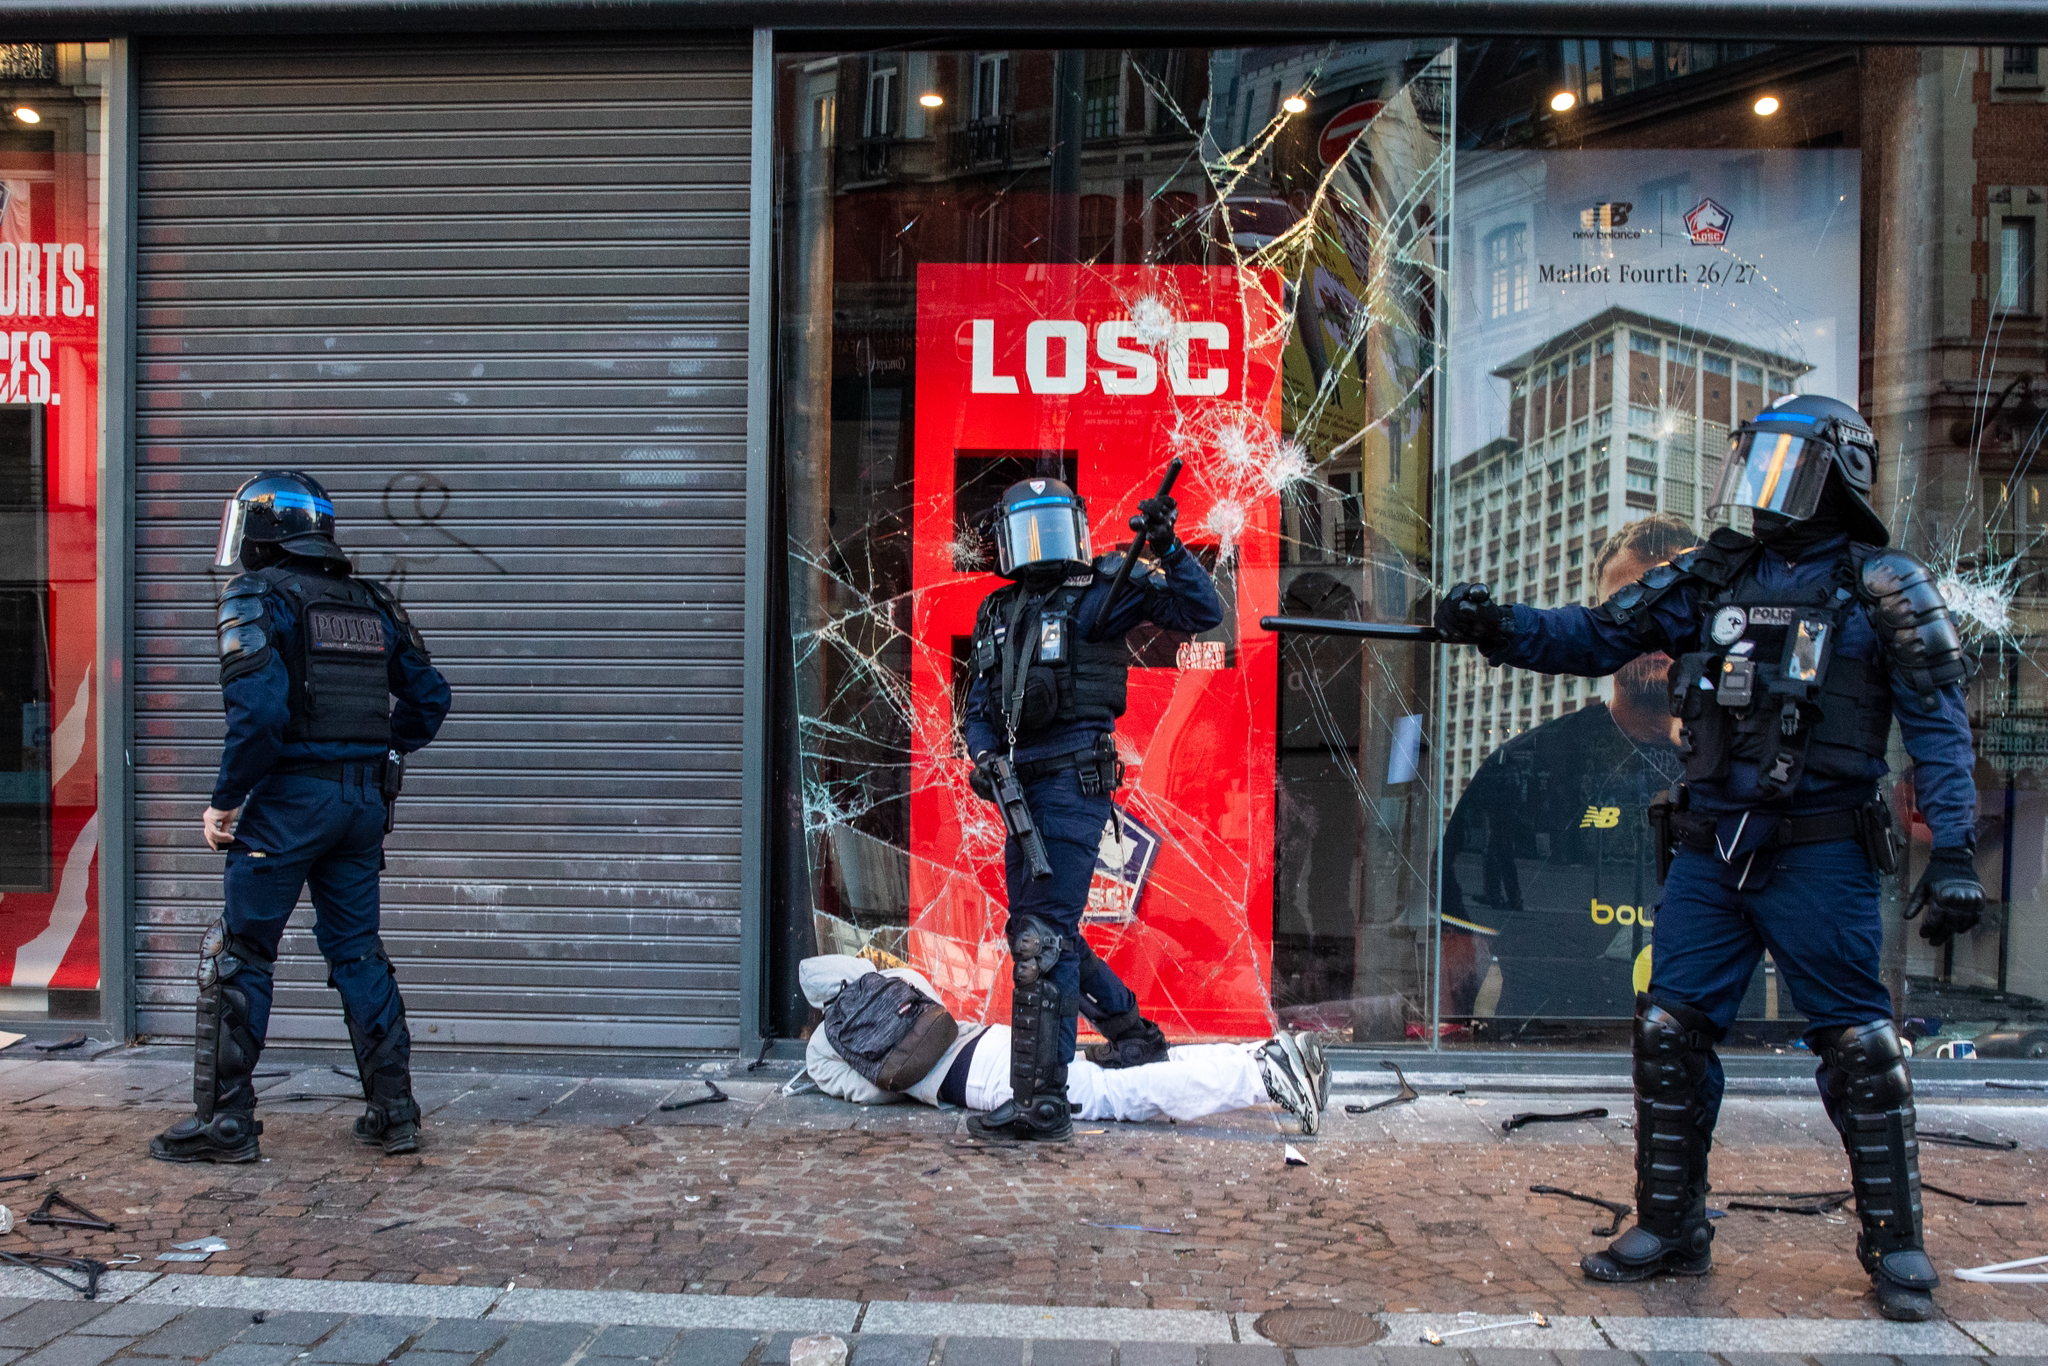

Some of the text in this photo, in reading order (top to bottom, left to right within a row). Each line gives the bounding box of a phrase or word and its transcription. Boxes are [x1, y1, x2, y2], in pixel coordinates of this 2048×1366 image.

[1573, 229, 1641, 240] new balance
[1695, 232, 1721, 242] LOSC
[1538, 262, 1757, 287] Maillot Fourth 26/27
[971, 318, 1230, 396] LOSC
[1752, 607, 1796, 620] POLIC
[314, 614, 385, 644] POLICE
[1579, 805, 1621, 828] NB
